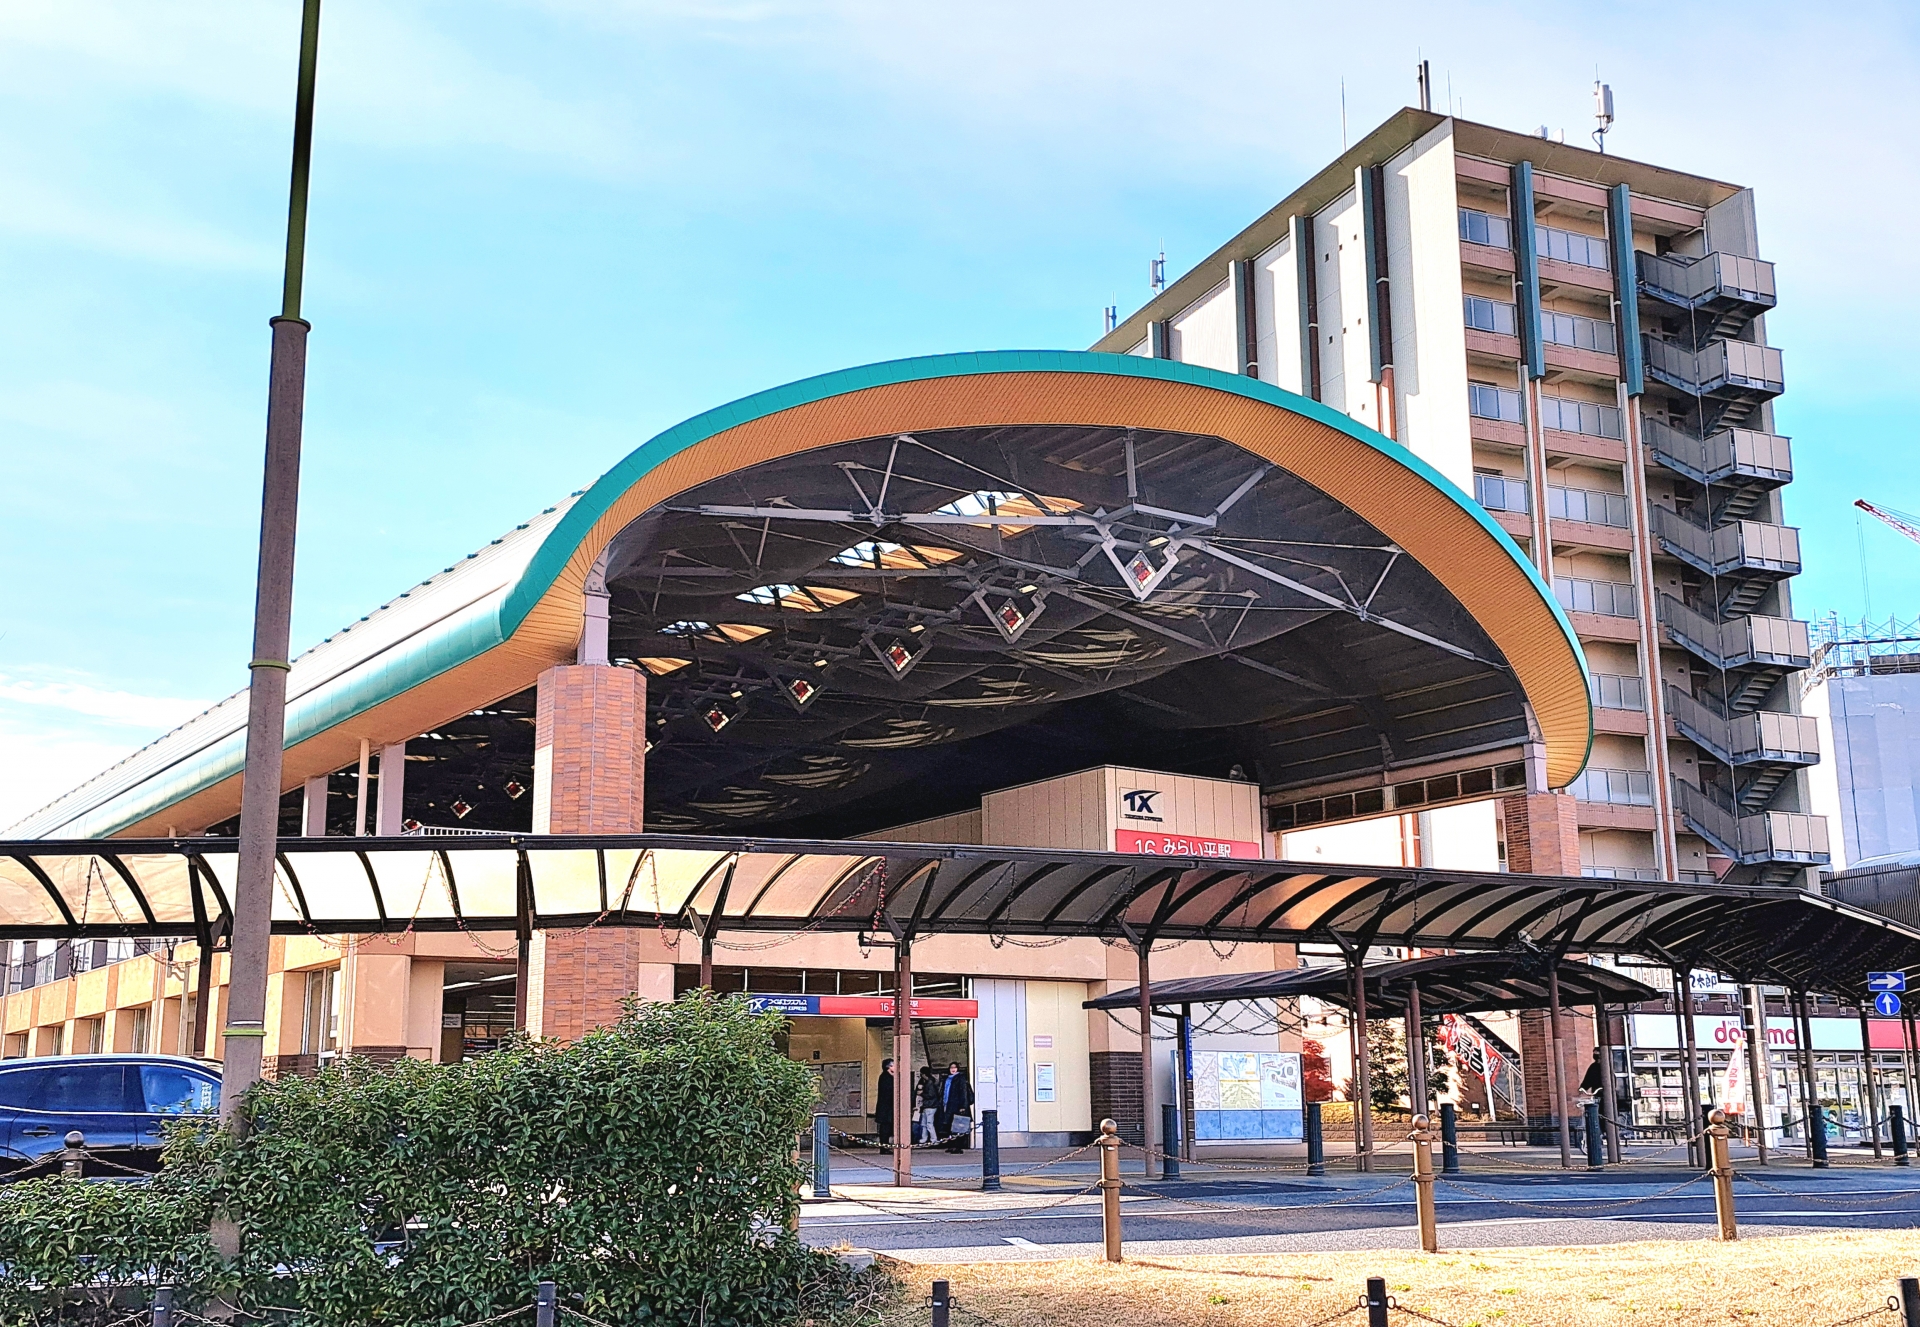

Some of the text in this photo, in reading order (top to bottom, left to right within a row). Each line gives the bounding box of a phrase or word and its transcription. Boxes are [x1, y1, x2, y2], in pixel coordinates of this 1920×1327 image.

[1123, 789, 1163, 814] TX
[1135, 838, 1232, 858] 16 みらい平駅
[880, 1002, 889, 1012] 16
